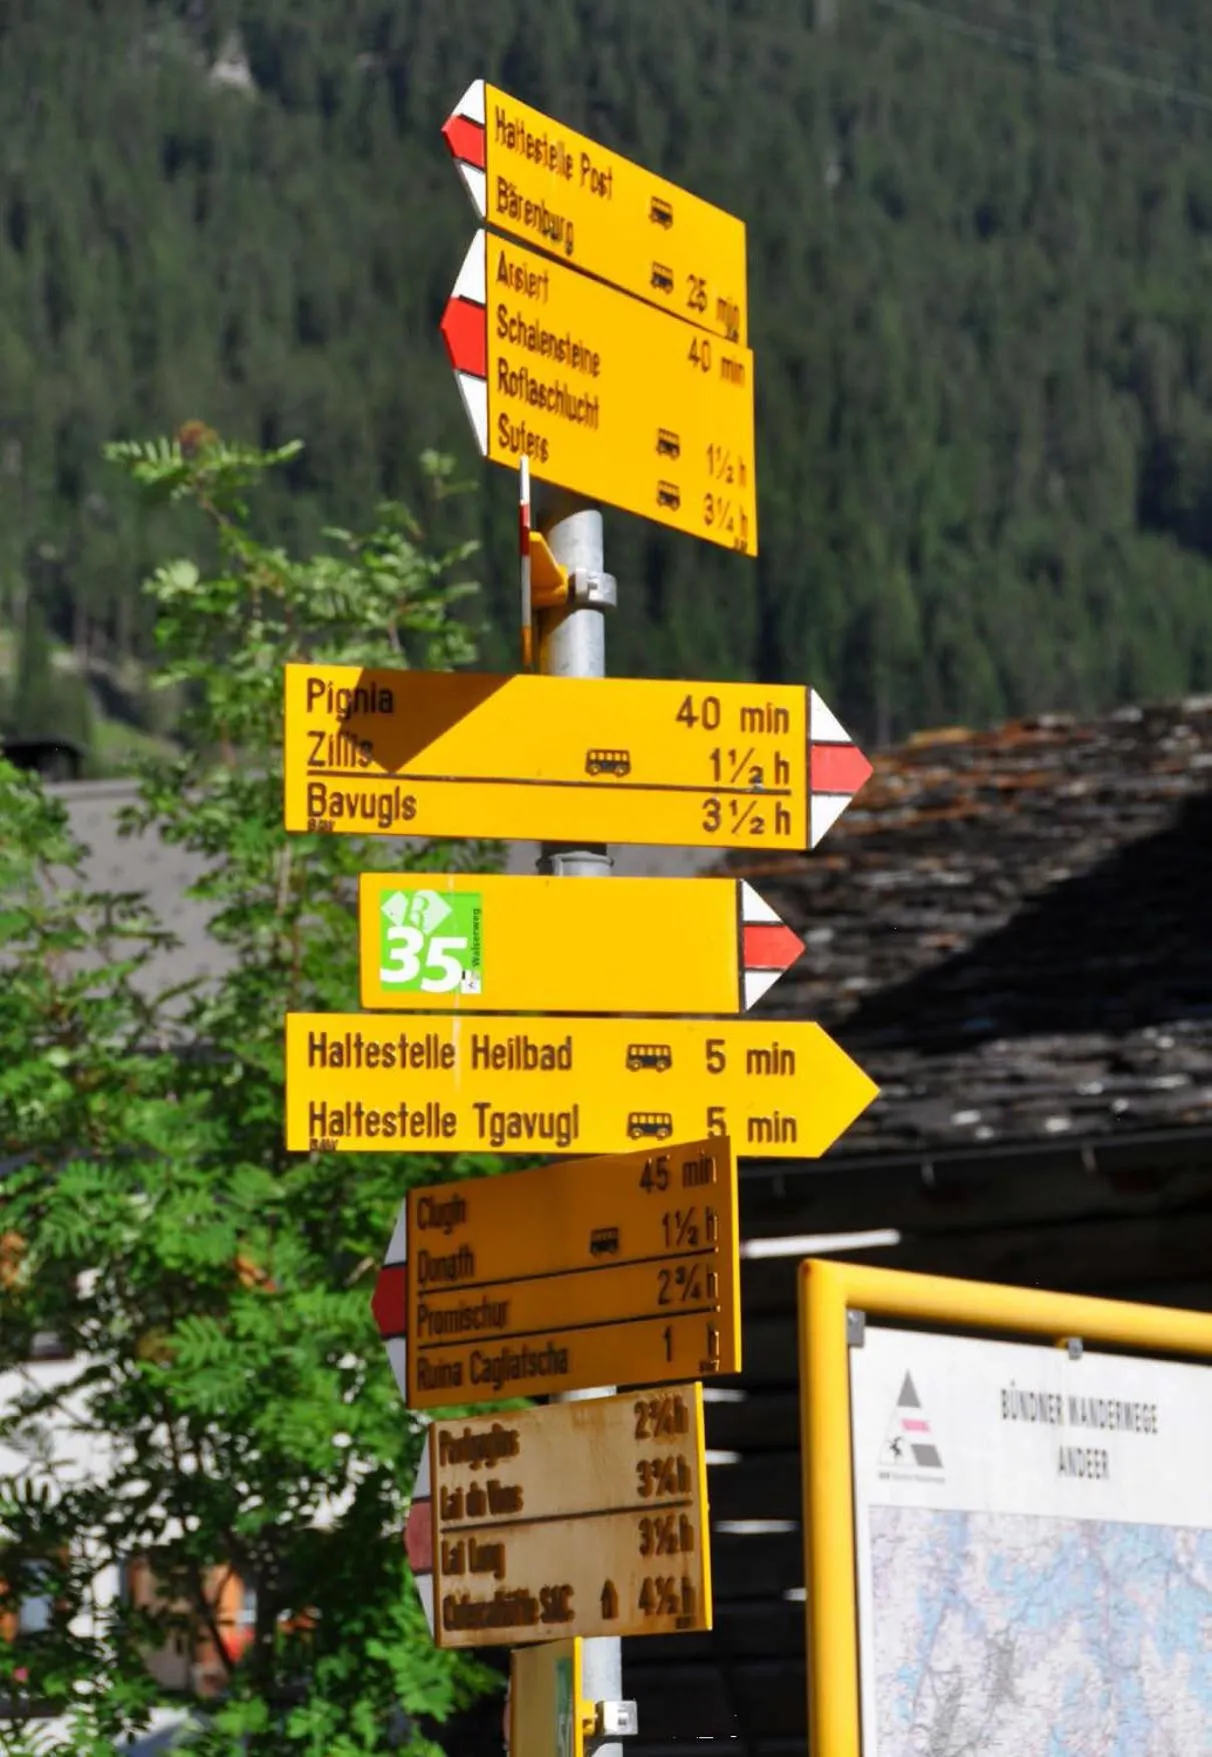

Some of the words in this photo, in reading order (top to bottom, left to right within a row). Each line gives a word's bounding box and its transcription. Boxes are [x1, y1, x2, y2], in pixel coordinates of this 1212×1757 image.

[495, 106, 573, 180] Haltestelle
[580, 151, 613, 199] Post
[496, 175, 574, 256] Bärenburg
[686, 274, 708, 313] 25
[497, 250, 549, 304] Arsiert
[688, 336, 711, 373] 40
[720, 355, 745, 388] min
[497, 304, 601, 378] Schalensteine
[497, 357, 599, 430] Roflaschlucht
[738, 454, 747, 488] h
[306, 677, 395, 722] Pignia
[675, 694, 721, 731] 40
[740, 702, 790, 735] min
[306, 730, 374, 768] Zillis
[774, 751, 790, 786] h
[306, 781, 418, 828] Bavugls
[775, 801, 791, 836] h
[380, 926, 468, 993] 35
[308, 1031, 456, 1069] Haltestelle
[471, 1034, 573, 1071] Heilbad
[706, 1039, 726, 1074] 5
[746, 1042, 796, 1077] min
[308, 1101, 457, 1138] Haltestelle
[472, 1101, 580, 1148] Tgavugl
[707, 1106, 728, 1138] 5
[747, 1111, 797, 1143] min
[640, 1154, 671, 1194] 45
[683, 1149, 717, 1187] min
[706, 1206, 718, 1241] h
[417, 1296, 510, 1339] Promischur
[706, 1263, 719, 1299] h
[663, 1324, 673, 1363] 1
[1001, 1379, 1064, 1425] BÜNDNER
[1068, 1392, 1159, 1434] WANDERWEGE
[1058, 1445, 1110, 1480] ANDEER
